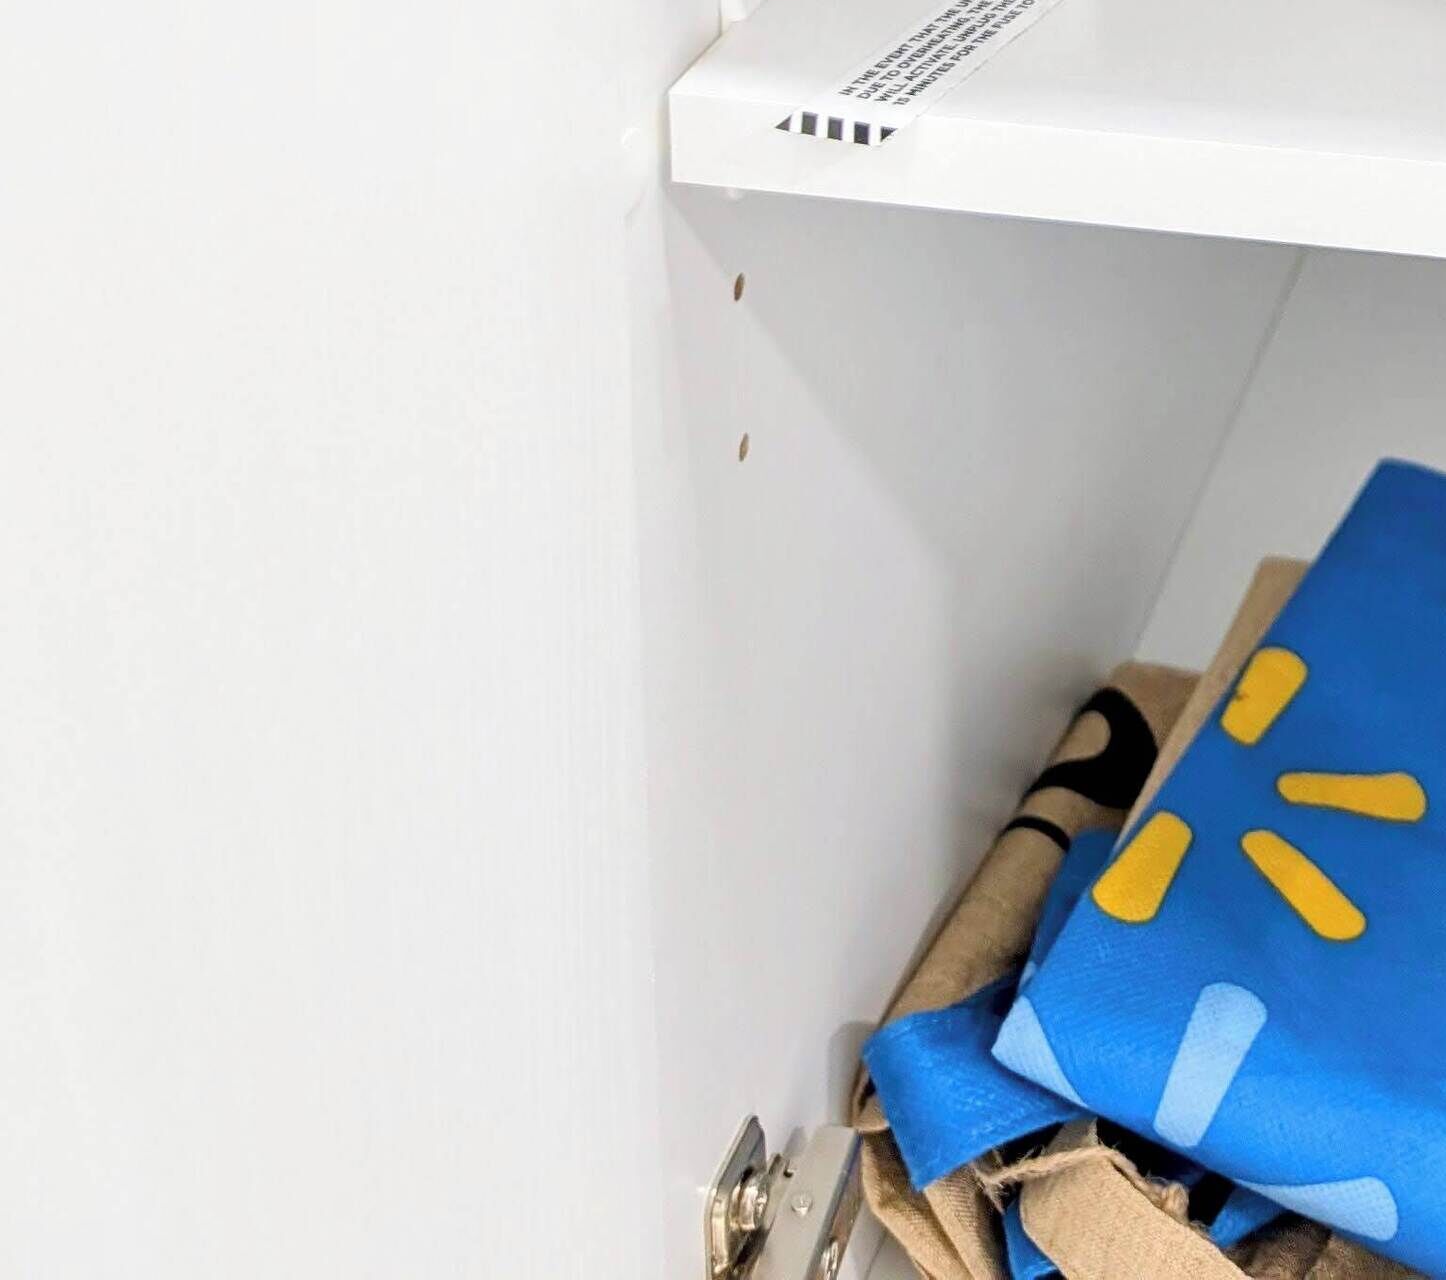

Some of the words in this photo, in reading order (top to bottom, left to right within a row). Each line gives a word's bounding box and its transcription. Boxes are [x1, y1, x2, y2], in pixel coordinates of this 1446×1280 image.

[838, 86, 859, 96] IN
[852, 69, 880, 85] THE
[874, 43, 913, 69] EVENT
[908, 23, 939, 42] THAT
[934, 8, 961, 22] THE
[856, 81, 886, 99] DUE
[879, 69, 900, 81] TO
[967, 0, 992, 14] THE
[874, 83, 909, 101] WILL
[953, 12, 997, 42] UNPLUG
[892, 97, 911, 105] 15
[905, 62, 956, 96] MINUTES
[949, 43, 978, 61] FOR
[971, 29, 998, 43] THE
[991, 9, 1023, 29] FUSE
